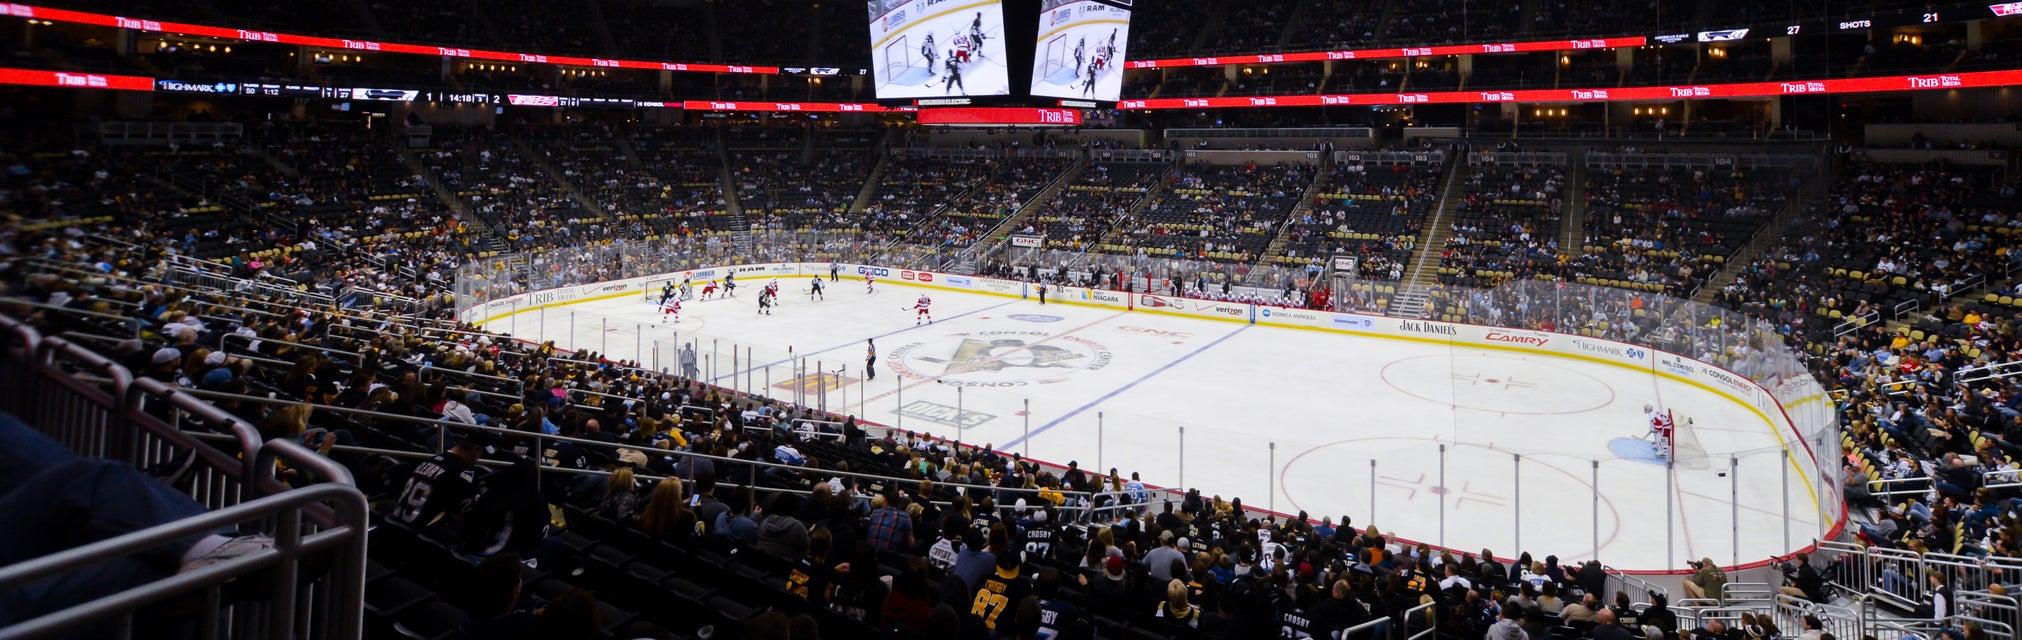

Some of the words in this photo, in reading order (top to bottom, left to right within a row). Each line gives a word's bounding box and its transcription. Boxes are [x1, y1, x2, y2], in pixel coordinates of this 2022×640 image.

[1923, 12, 1938, 23] 21
[116, 17, 141, 29] TRIB
[1840, 20, 1871, 30] SHOTS
[1787, 26, 1800, 35] 27
[238, 30, 261, 41] TRIB
[343, 40, 364, 49] TRIB
[1571, 40, 1591, 48] TRIB
[438, 47, 456, 56] TRIB
[1908, 78, 1939, 87] TRIB
[1670, 88, 1693, 96] TRIB
[1781, 83, 1806, 92] TRIB
[426, 93, 432, 101] 1
[493, 95, 500, 103] 2
[1571, 91, 1592, 99] TRIB
[1321, 96, 1337, 104] TRIB
[1038, 110, 1060, 122] TRIB
[693, 271, 715, 279] LUMBER
[858, 266, 889, 277] GCO
[602, 283, 628, 291] verizon
[527, 292, 554, 306] TRIB
[1093, 295, 1119, 303] NIAGARA
[1216, 306, 1243, 315] verizon
[1293, 313, 1317, 321] MINOLTA
[1116, 326, 1197, 338] GNC
[1399, 320, 1422, 333] JACK
[1423, 321, 1457, 336] DANIEL'S
[1485, 332, 1549, 346] CAMRY
[1709, 369, 1733, 384] CONSOL
[576, 455, 587, 468] 87
[1027, 530, 1053, 539] CROSBY
[971, 588, 1009, 631] 87
[1283, 612, 1311, 629] CROSBY
